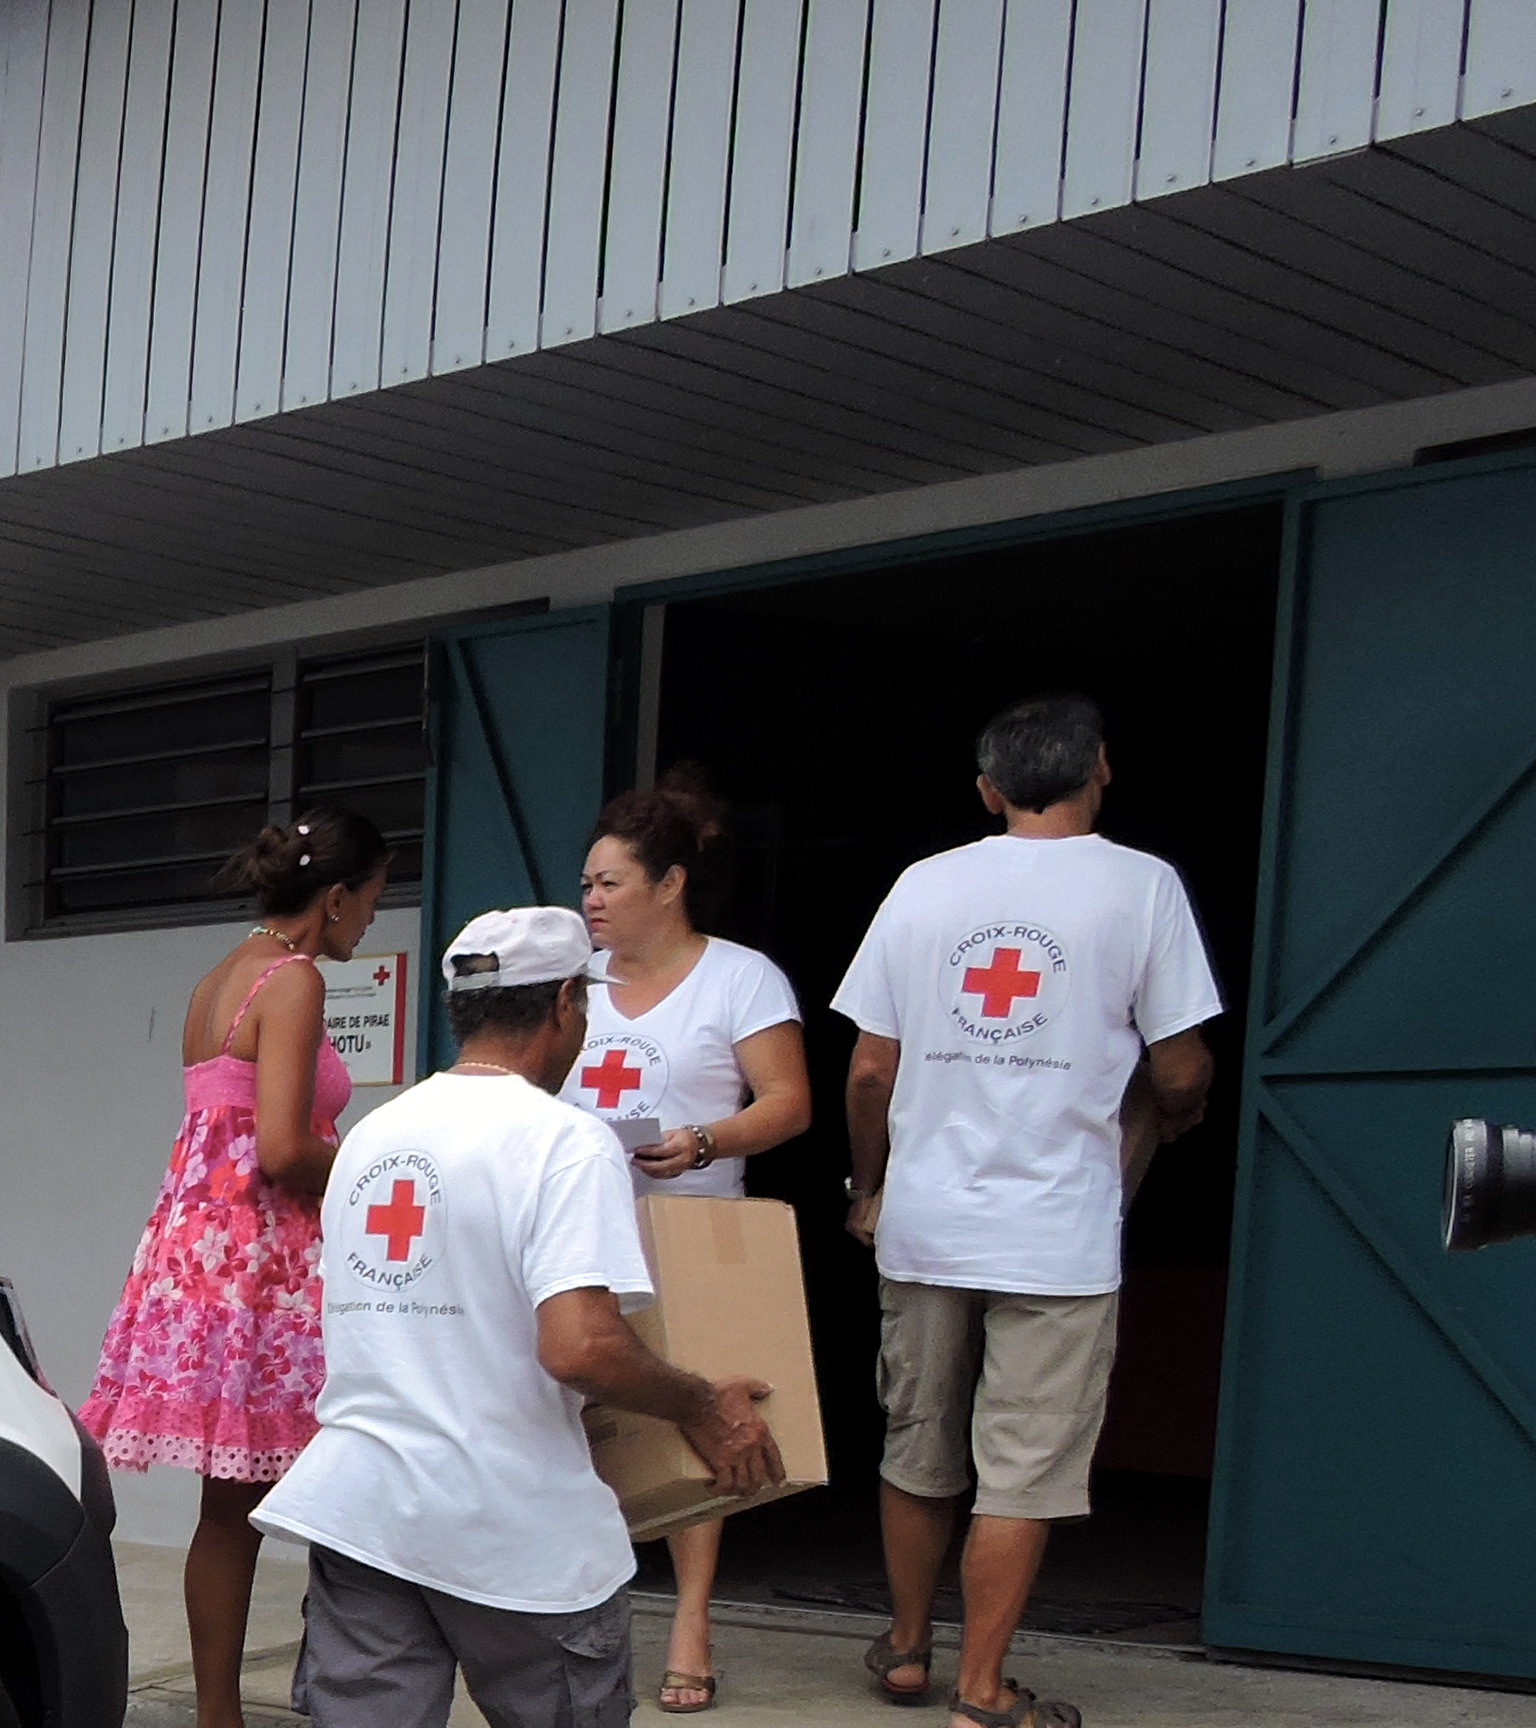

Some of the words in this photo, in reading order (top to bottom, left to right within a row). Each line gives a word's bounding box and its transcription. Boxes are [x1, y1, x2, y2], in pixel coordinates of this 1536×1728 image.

[948, 925, 1067, 974] CROIX-ROUGE
[348, 1015, 362, 1028] DE
[363, 1013, 391, 1028] PIRAE
[974, 1053, 991, 1065] de
[993, 1054, 1005, 1065] la
[348, 1154, 442, 1207] CROIX-ROUGE
[346, 1252, 433, 1291] FRANÇAISE
[376, 1301, 395, 1314] de
[398, 1302, 409, 1314] la
